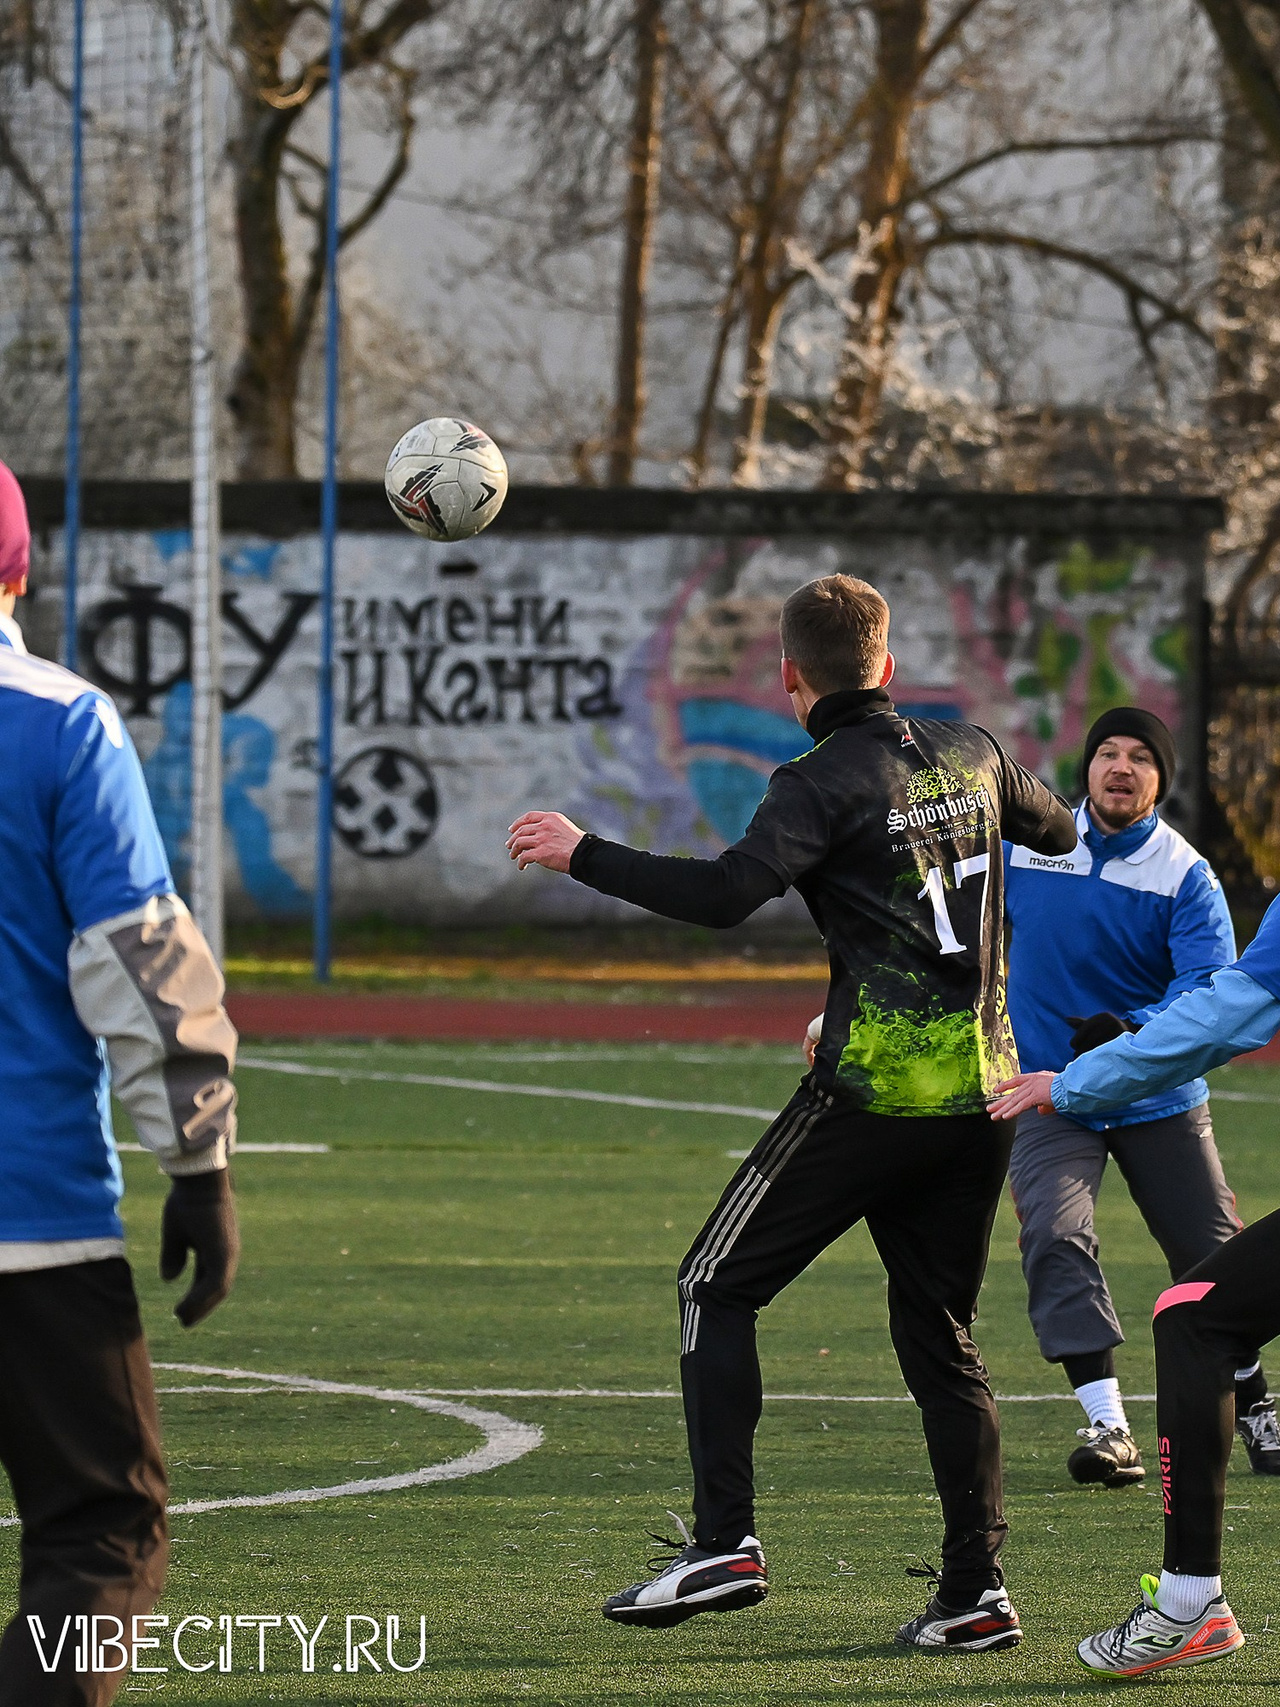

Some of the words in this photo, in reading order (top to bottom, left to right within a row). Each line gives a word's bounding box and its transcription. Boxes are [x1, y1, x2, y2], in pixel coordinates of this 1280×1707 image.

[886, 784, 991, 834] Schönbusch
[891, 836, 934, 853] Brauerei
[936, 822, 985, 842] Königsberg
[917, 852, 990, 955] 17
